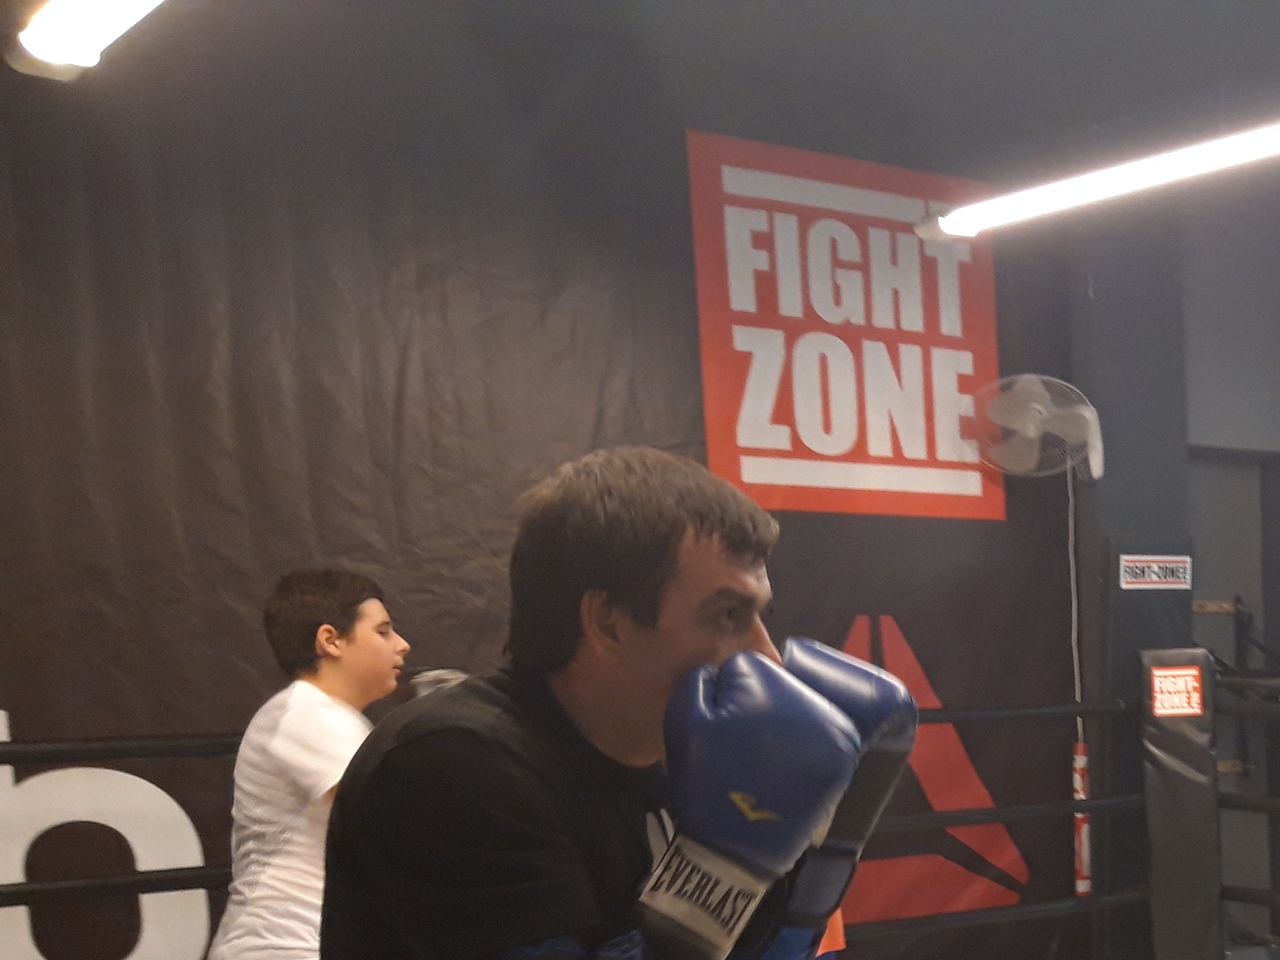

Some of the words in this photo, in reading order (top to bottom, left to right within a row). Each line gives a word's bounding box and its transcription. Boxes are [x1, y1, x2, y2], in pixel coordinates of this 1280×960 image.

[724, 204, 972, 337] FIGHT
[732, 324, 981, 464] ZONE
[649, 843, 755, 936] EVERLAST
